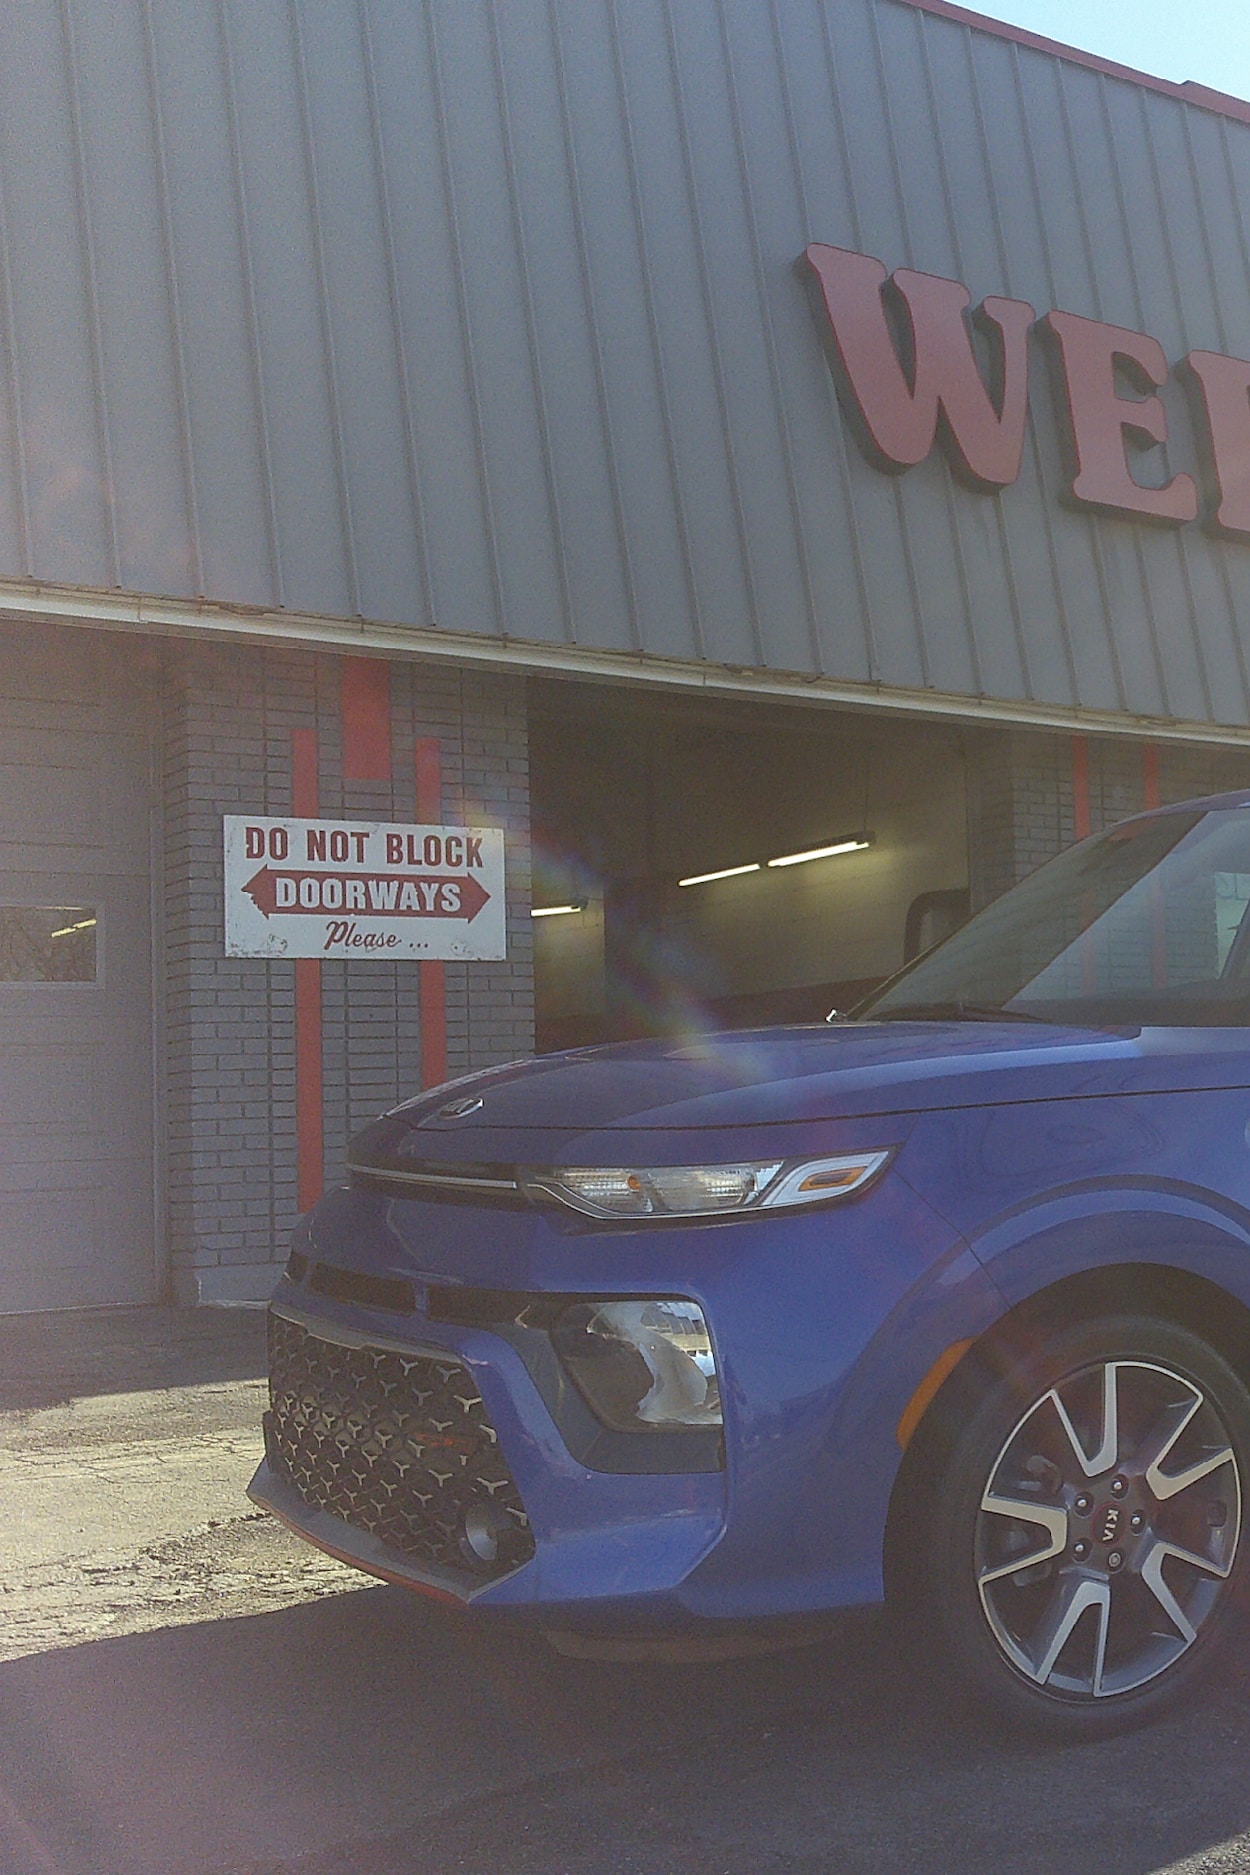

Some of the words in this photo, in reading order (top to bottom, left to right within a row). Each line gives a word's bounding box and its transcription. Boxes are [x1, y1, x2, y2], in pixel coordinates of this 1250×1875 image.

[245, 826, 289, 861] DO
[306, 829, 370, 864] NOT
[386, 833, 484, 868] BLOCK
[275, 876, 461, 912] DOORWAYS
[323, 920, 402, 951] Please
[1102, 1509, 1119, 1541] KIA
